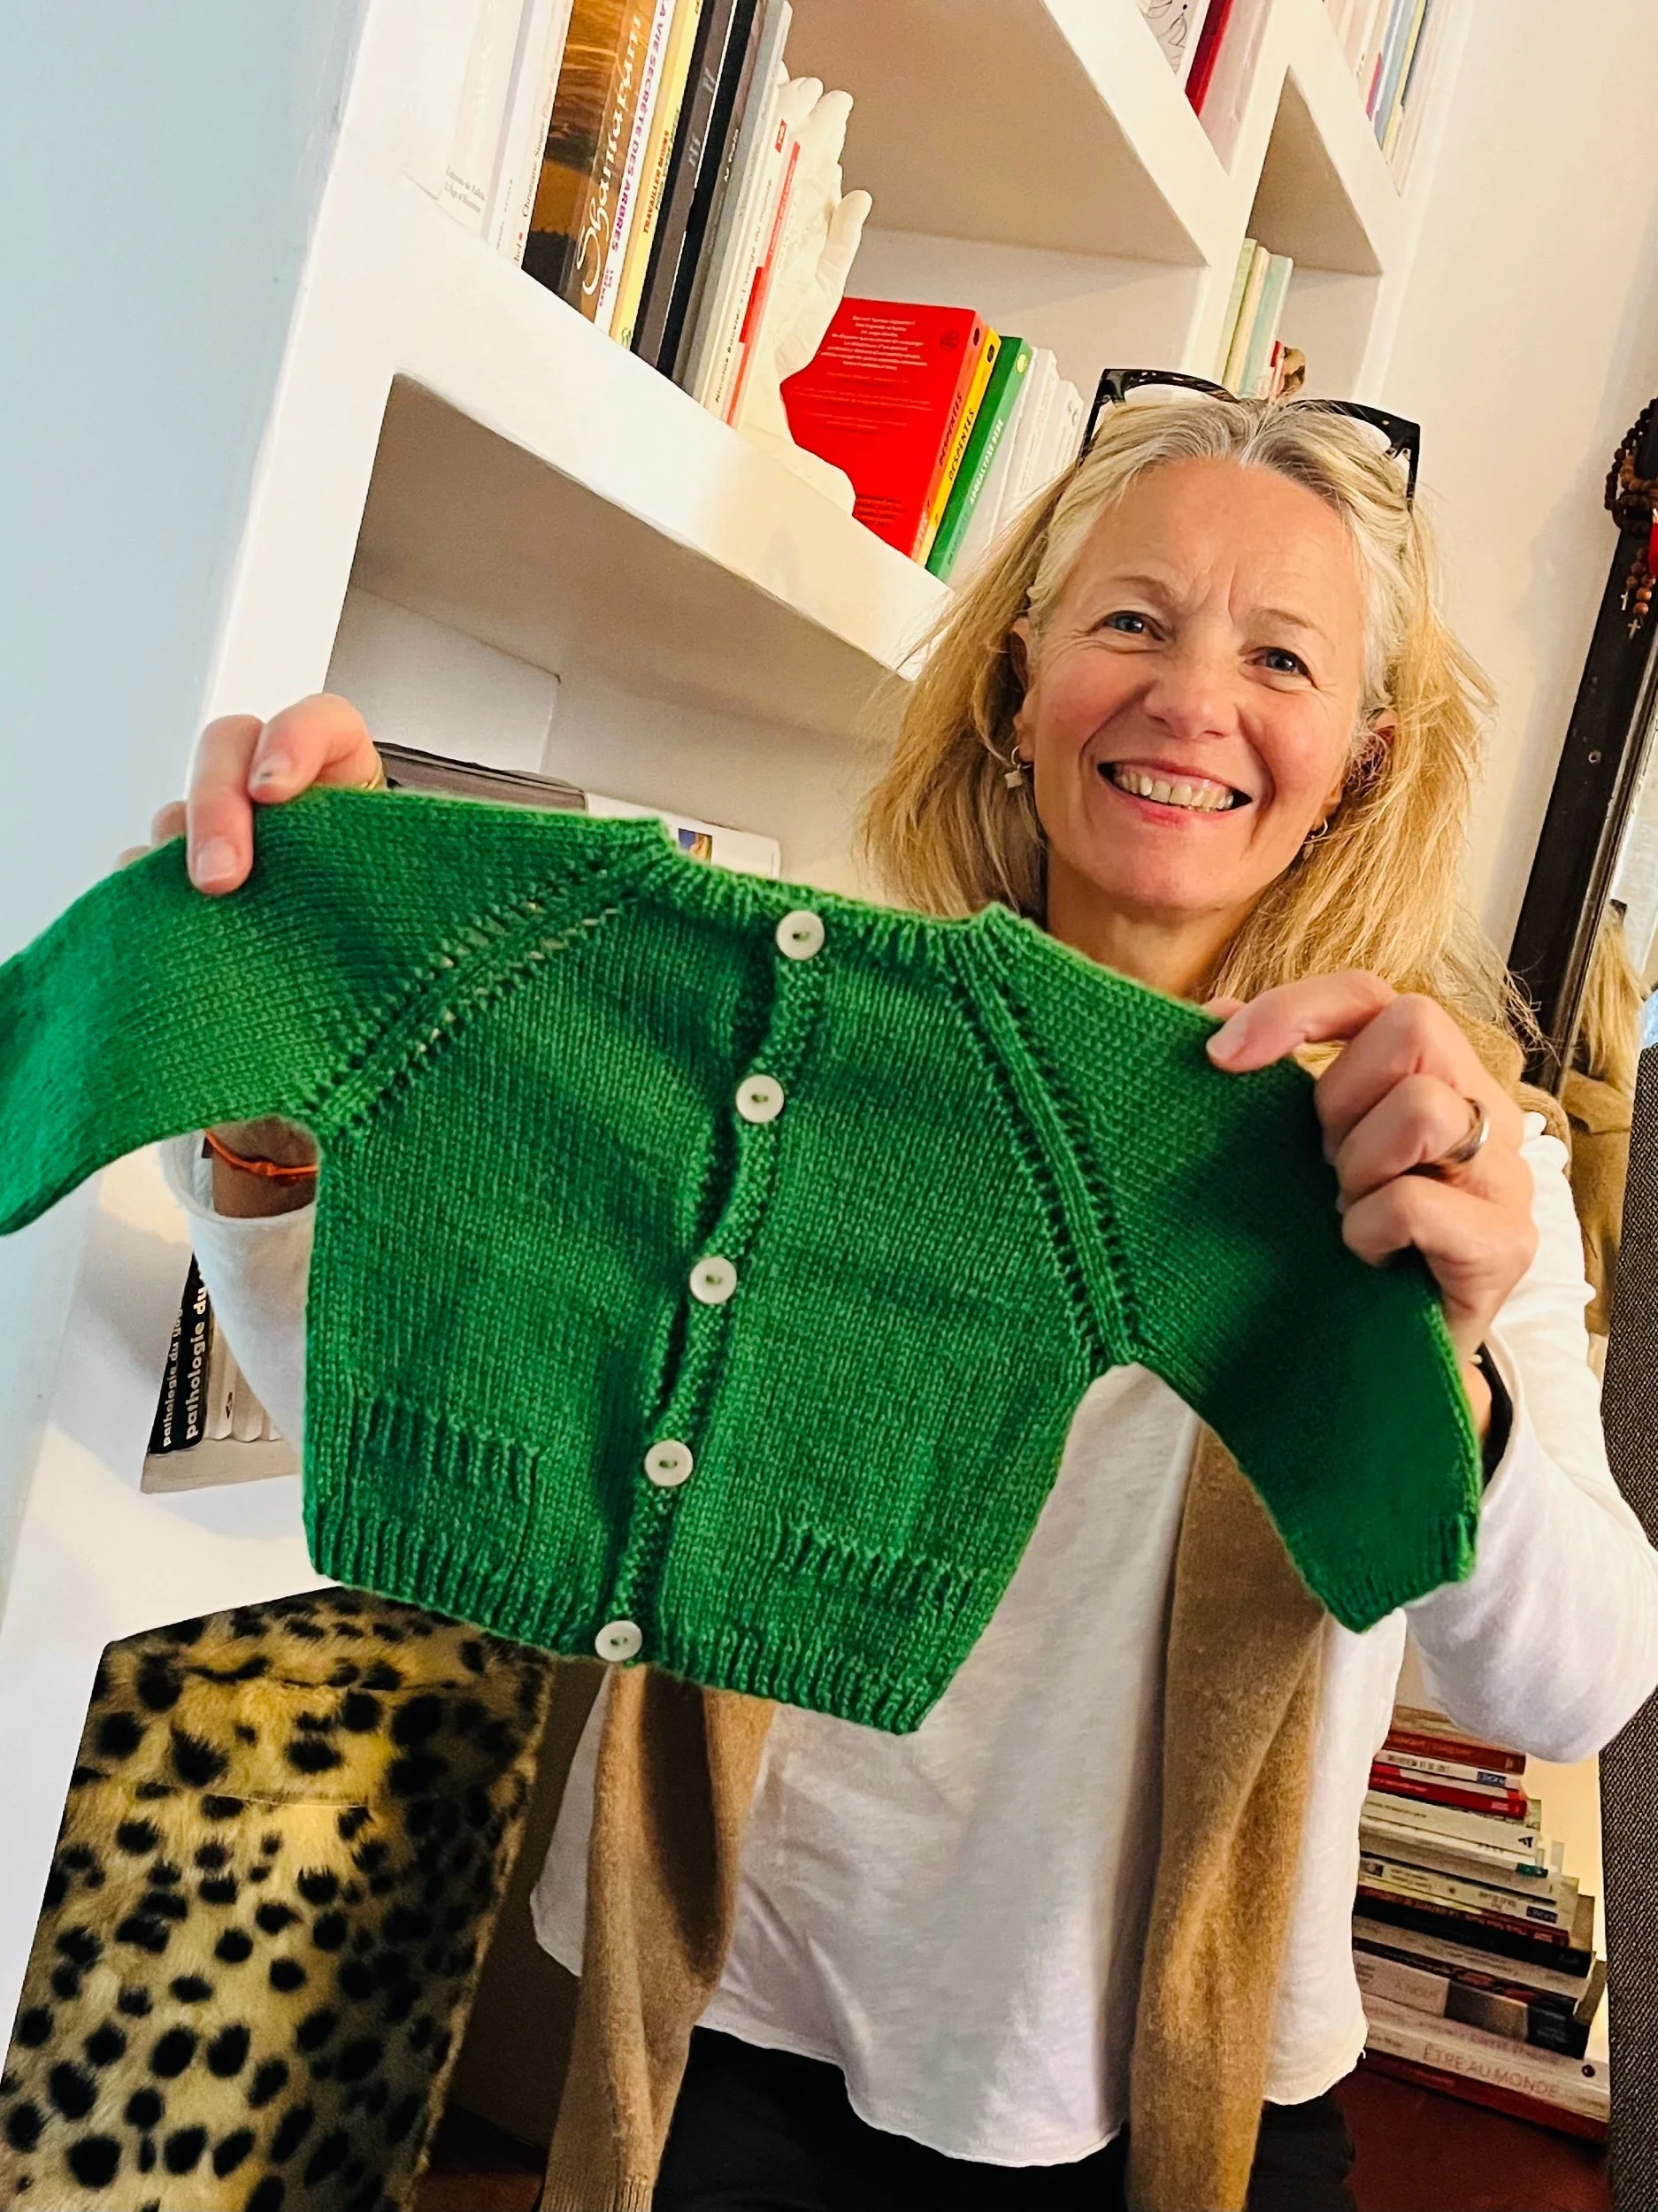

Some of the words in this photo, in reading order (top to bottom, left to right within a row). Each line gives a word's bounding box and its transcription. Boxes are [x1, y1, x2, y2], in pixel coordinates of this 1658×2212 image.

[653, 22, 664, 52] VIE
[576, 13, 641, 296] Shantaram
[627, 141, 640, 176] DES
[642, 166, 661, 234] TRAVAILLER
[658, 129, 670, 166] MOINS
[612, 180, 630, 252] ARBRES
[940, 392, 963, 467] DESPENTES
[948, 407, 975, 481] DESPENTES
[969, 442, 995, 506] APOCALYPSE
[193, 1286, 208, 1316] du
[168, 1340, 180, 1363] du
[185, 1321, 206, 1440] pathologie
[163, 1365, 178, 1448] pathologie
[1470, 2060, 1492, 2078] AU
[1493, 2067, 1559, 2099] MONDE
